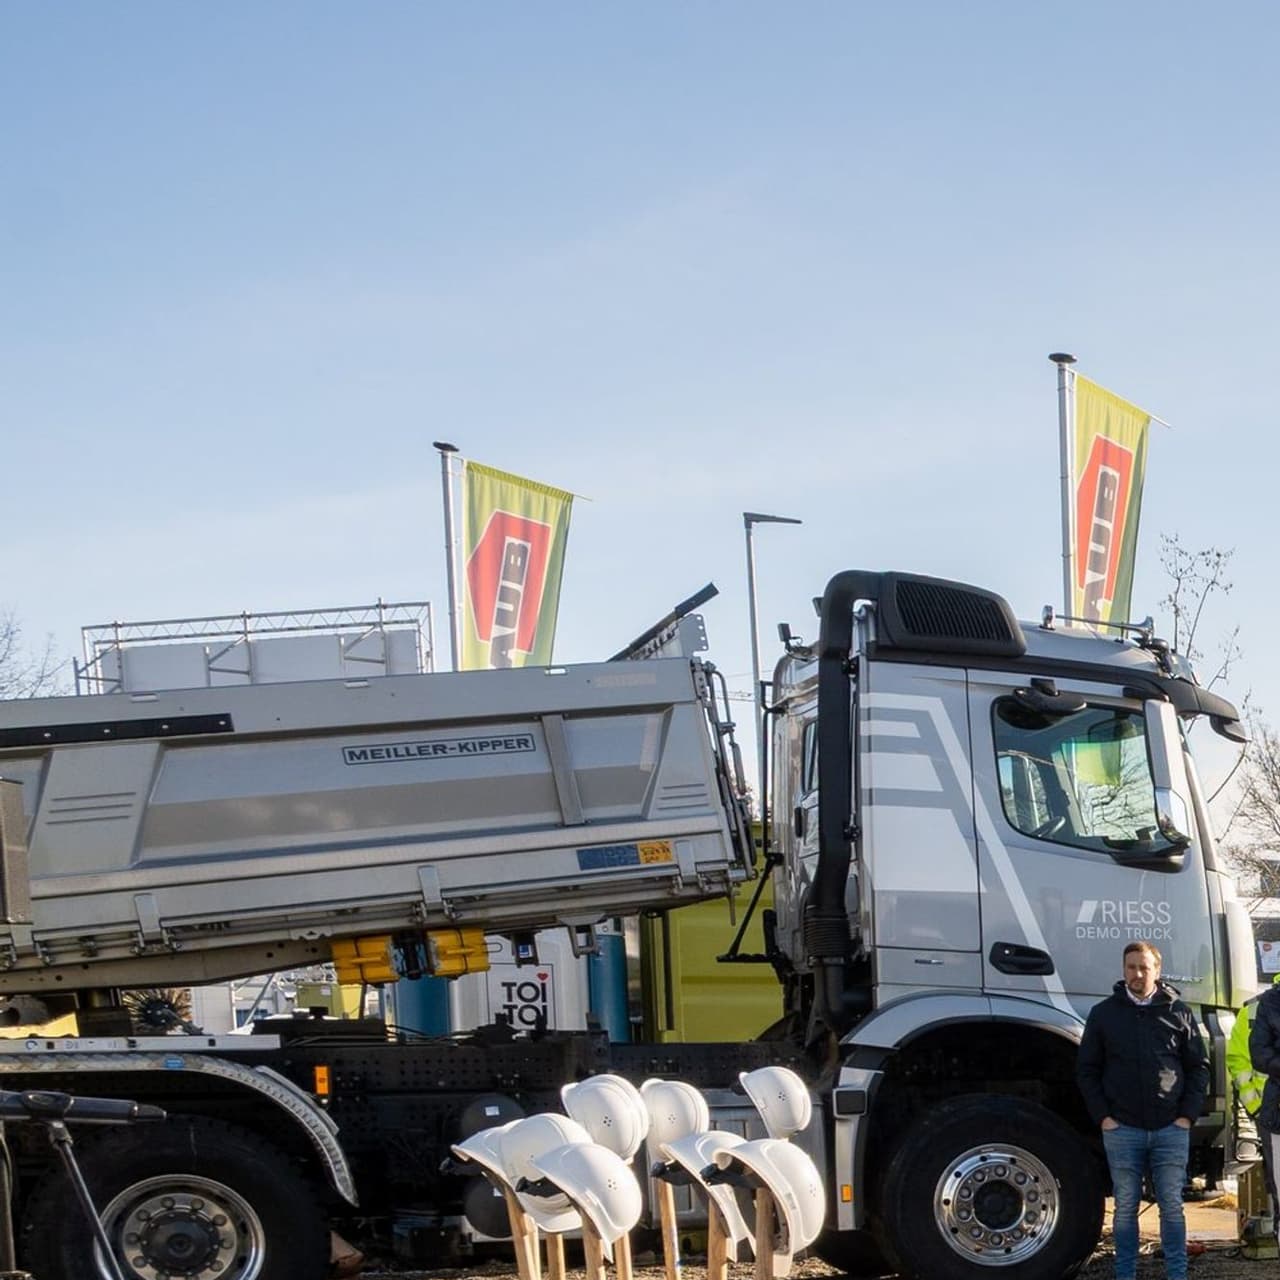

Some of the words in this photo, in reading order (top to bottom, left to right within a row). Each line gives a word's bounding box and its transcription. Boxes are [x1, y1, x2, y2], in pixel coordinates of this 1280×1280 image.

[349, 737, 531, 762] MEILLER-KIPPER
[1101, 900, 1172, 925] RIESS
[1076, 926, 1121, 939] DEMO
[1124, 927, 1173, 940] TRUCK
